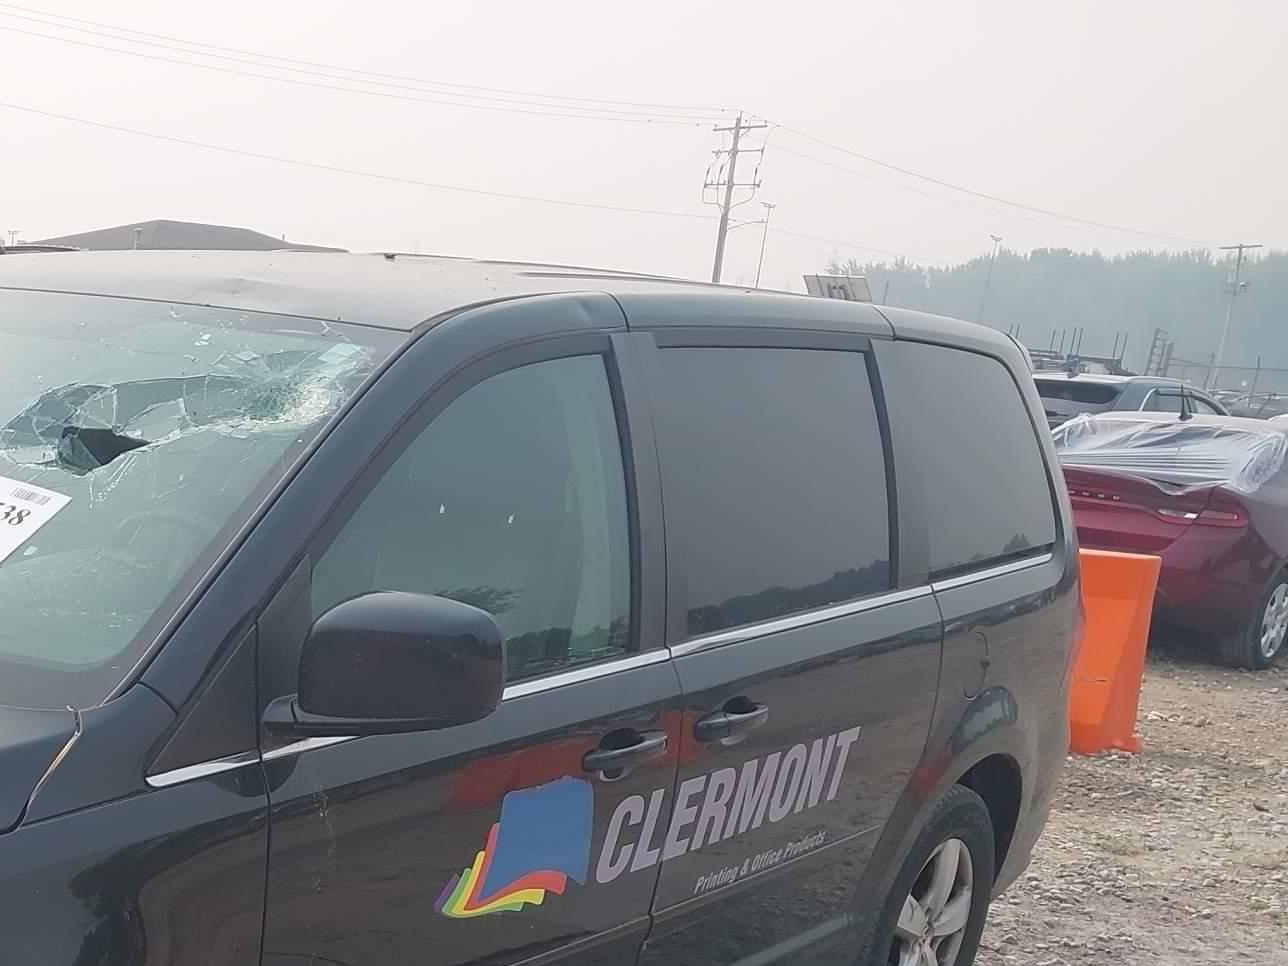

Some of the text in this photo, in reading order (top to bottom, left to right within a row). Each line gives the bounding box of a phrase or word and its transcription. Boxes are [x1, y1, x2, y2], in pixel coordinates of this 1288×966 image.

[595, 725, 863, 884] CLERMONT
[694, 831, 826, 894] Printing & Office Products
